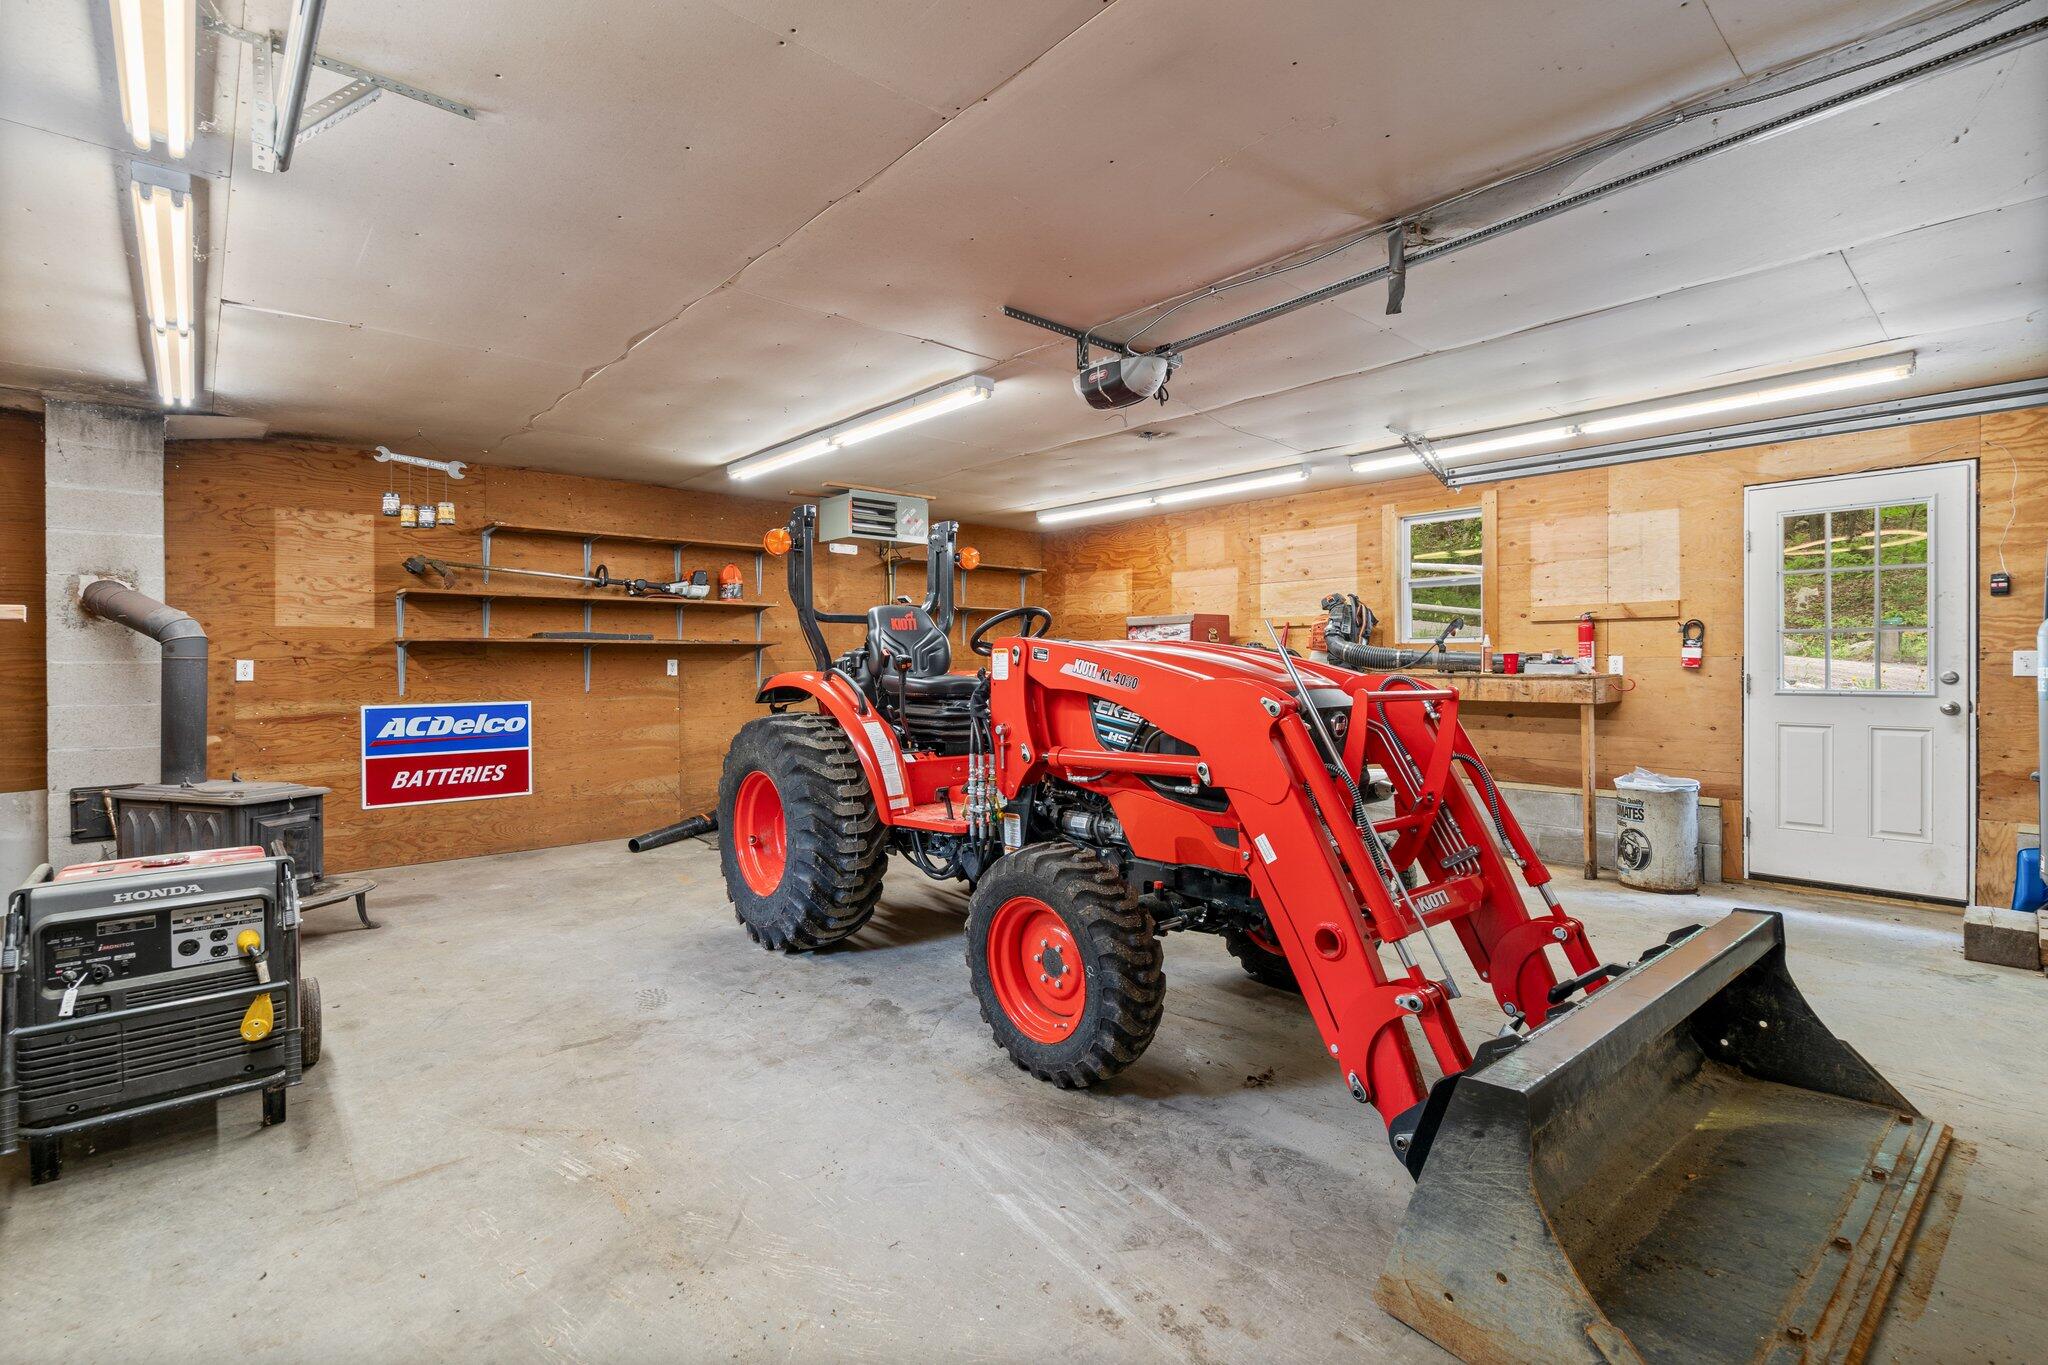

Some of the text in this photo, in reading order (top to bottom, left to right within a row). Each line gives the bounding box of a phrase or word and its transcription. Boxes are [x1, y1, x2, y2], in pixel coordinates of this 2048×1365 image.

[1073, 658, 1098, 679] KIOTI
[1100, 669, 1112, 682] KL
[376, 714, 526, 738] ACDelco
[391, 764, 507, 789] BATTERIES
[113, 884, 204, 903] HONDA
[1416, 889, 1451, 912] KIOTI
